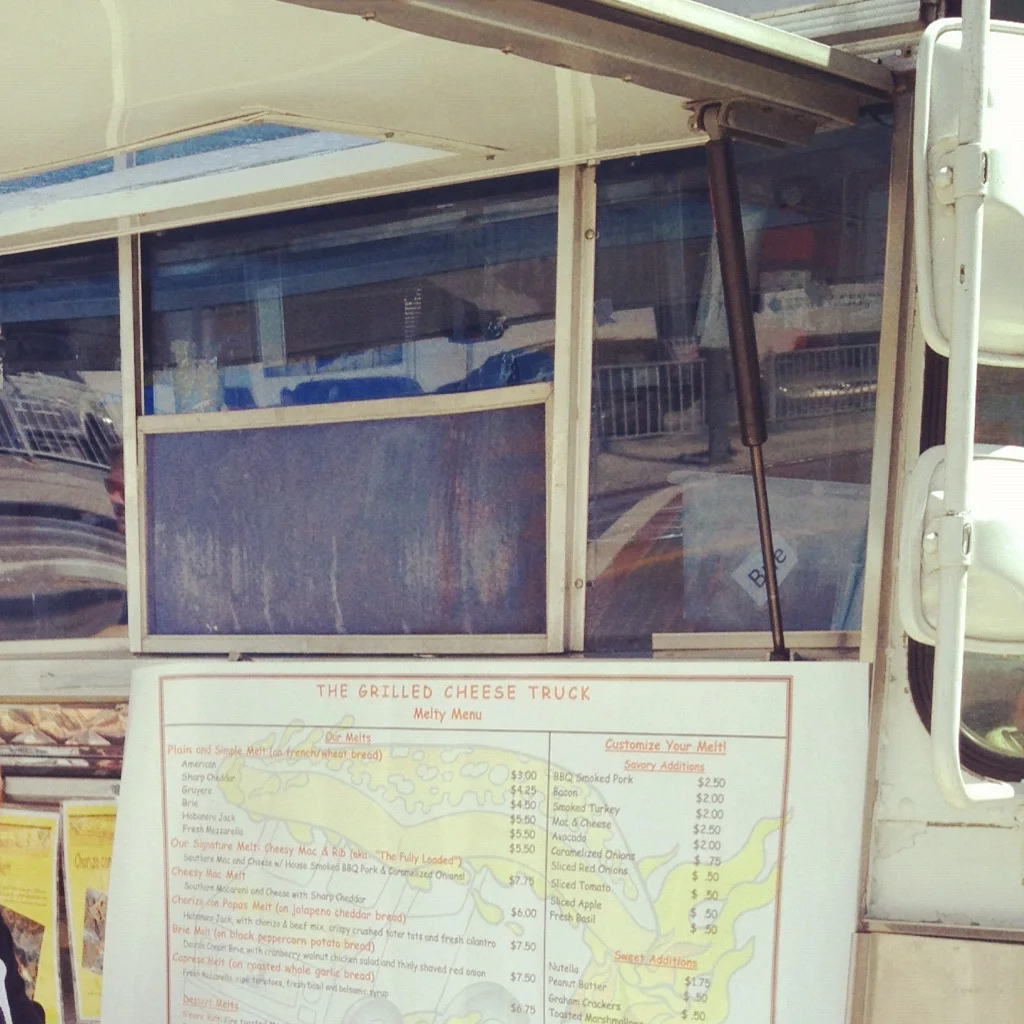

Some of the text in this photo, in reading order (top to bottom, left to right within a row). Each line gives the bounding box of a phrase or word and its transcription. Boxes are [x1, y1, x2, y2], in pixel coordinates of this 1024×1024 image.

[317, 684, 590, 700] THE GRILLED CHEESE TRUCK
[414, 708, 482, 722] Melty Menu
[326, 732, 371, 743] Our Melts
[605, 739, 726, 753] Customize Your Melt!
[168, 746, 383, 761] Plain and Simple Melt (on bread)
[624, 760, 704, 772] Savory Additions
[182, 774, 235, 782] Sharp Cheddar
[510, 771, 537, 780] $3.00
[553, 773, 725, 788] BBQ Smoked Pork $2.50
[182, 786, 212, 795] Gruyere
[510, 786, 536, 794] $4.25
[554, 787, 724, 803] Bacon $2.00
[510, 801, 536, 809] $4.50
[553, 803, 723, 819] Smoked Turkey $2.00
[510, 816, 535, 824] $5.50
[552, 818, 569, 827] Mac
[580, 820, 612, 829] Cheese
[693, 825, 721, 834] $2.50
[510, 830, 535, 839] $5.50
[552, 833, 721, 850] Avocado $2.00
[171, 840, 419, 864] Our Signature Cheesy Mac Rib Fully
[510, 845, 535, 853] $5.50
[551, 848, 635, 860] Caramelized Onions
[285, 861, 307, 870] House
[551, 863, 627, 875] Sliced Red Onions
[171, 868, 246, 880] Cheesy Mac Melt
[551, 880, 610, 892] Sliced Tomato
[550, 897, 602, 909] Sliced Apple
[172, 896, 406, 923] Chorizo Papas Melt (on cheddar bread)
[511, 908, 536, 918] $6.00
[550, 911, 595, 924] Fresh Basil
[311, 937, 375, 952] potato bread)
[510, 941, 536, 950] $7.50
[615, 951, 697, 969] Sweet Additions
[247, 961, 375, 982] roasted whole bread)
[510, 972, 536, 982] $7.50
[549, 963, 711, 988] Nutella $1.75
[549, 977, 607, 991] Peanut Butter
[549, 994, 621, 1010] Graham Crackers
[510, 1004, 536, 1014] $6.75
[549, 1009, 582, 1020] Toasted
